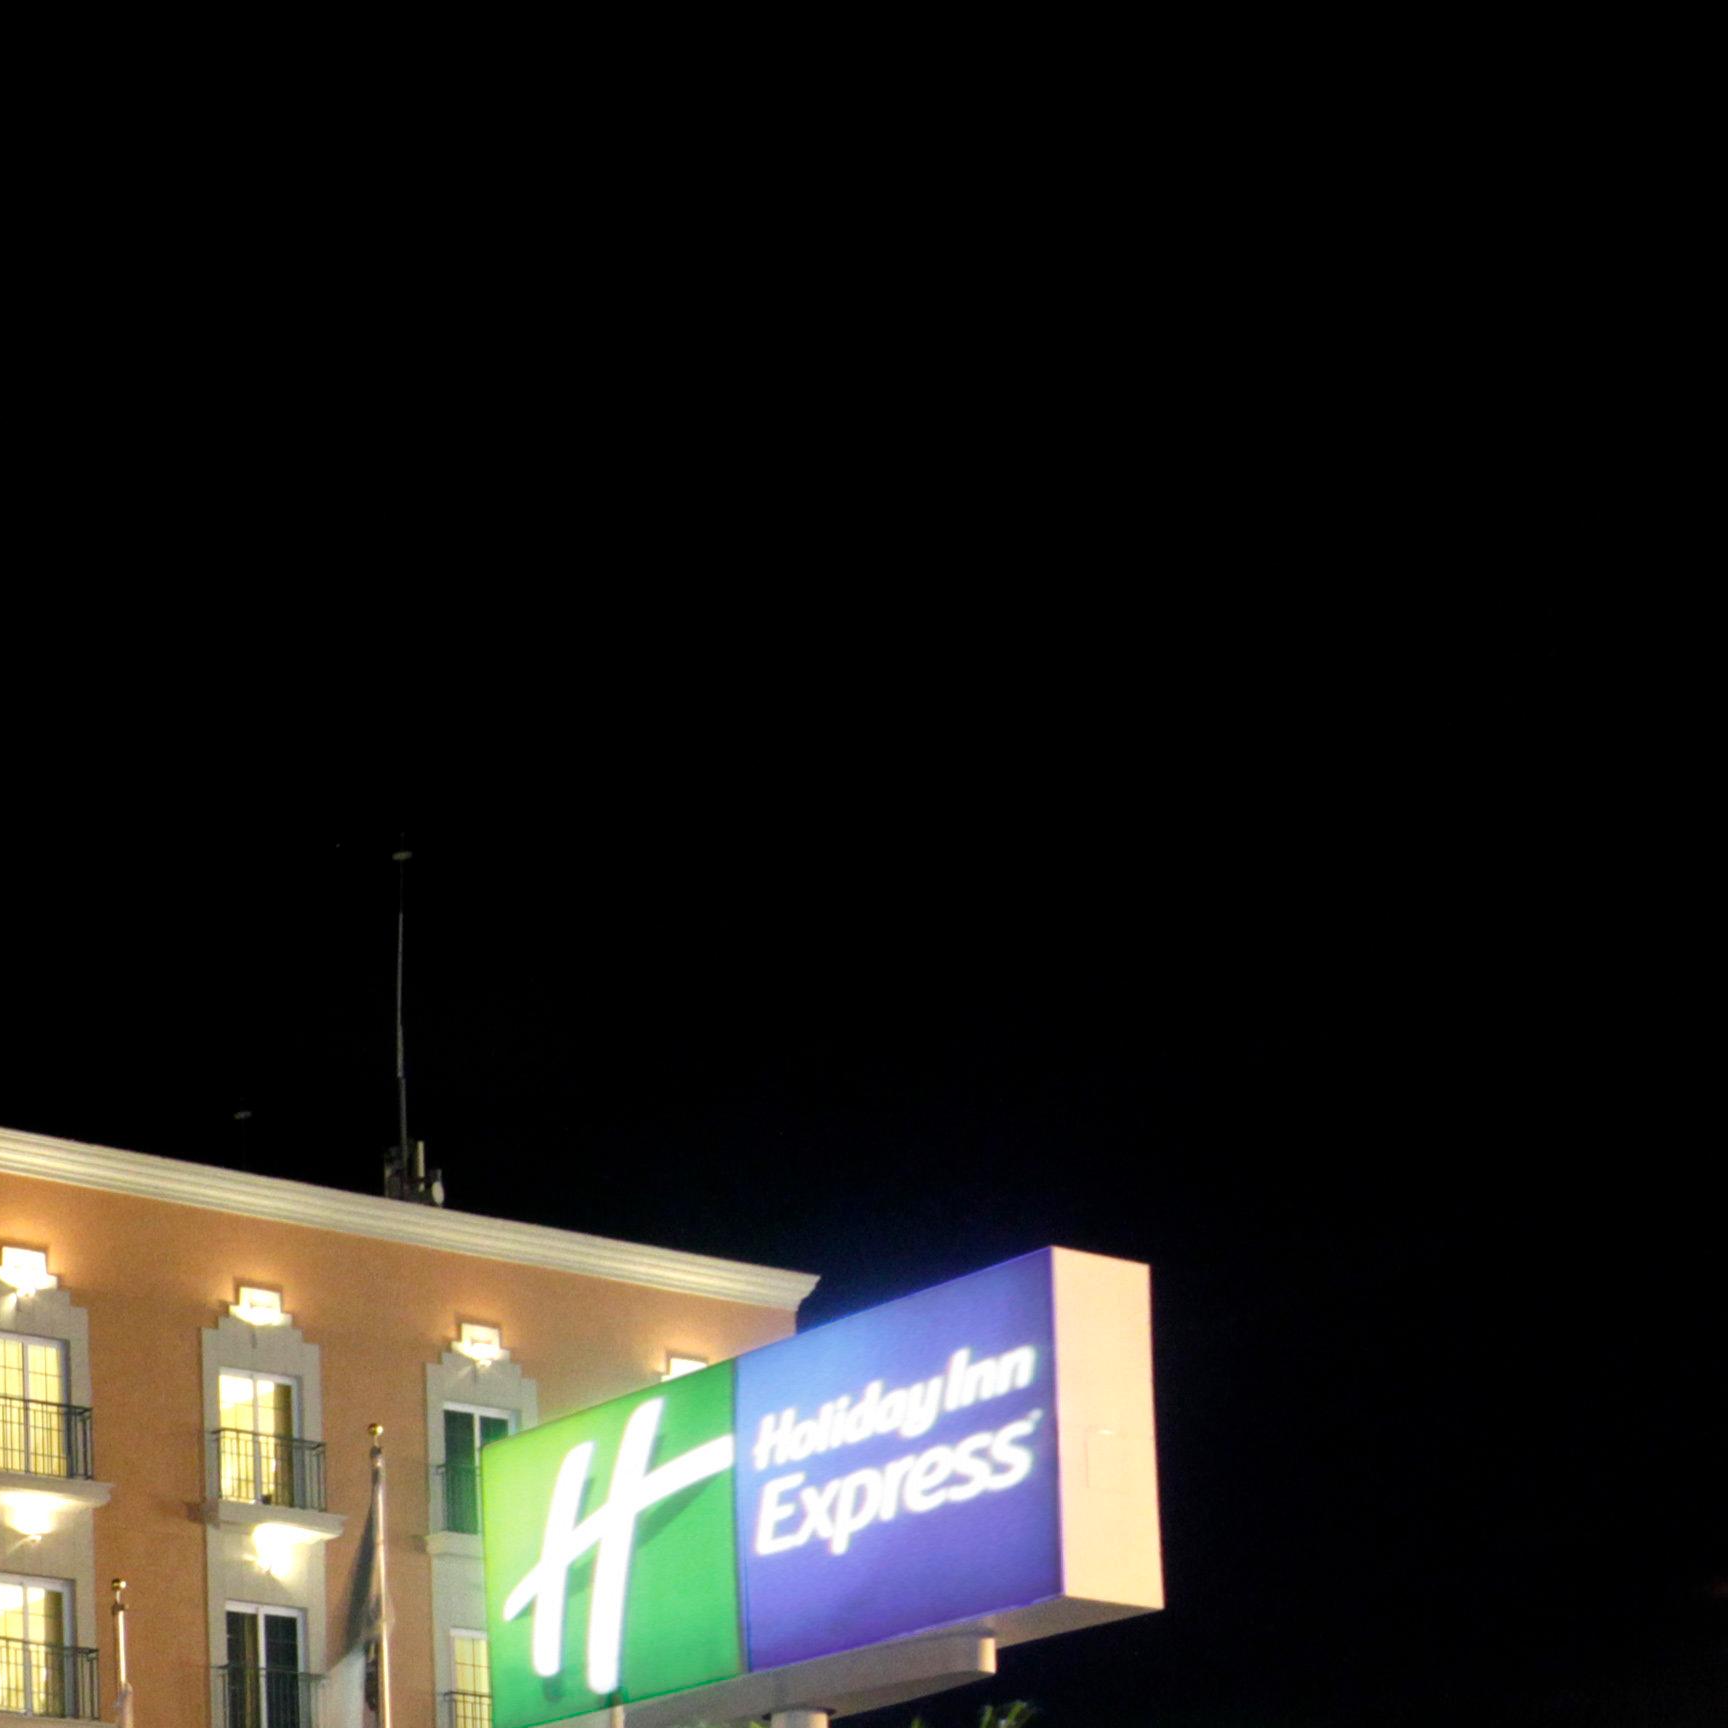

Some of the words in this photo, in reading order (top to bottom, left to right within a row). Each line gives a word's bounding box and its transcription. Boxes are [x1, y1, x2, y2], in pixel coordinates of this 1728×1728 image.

[754, 1378, 944, 1470] Holiday
[944, 1345, 1037, 1413] Inn
[755, 1417, 1035, 1556] Express
